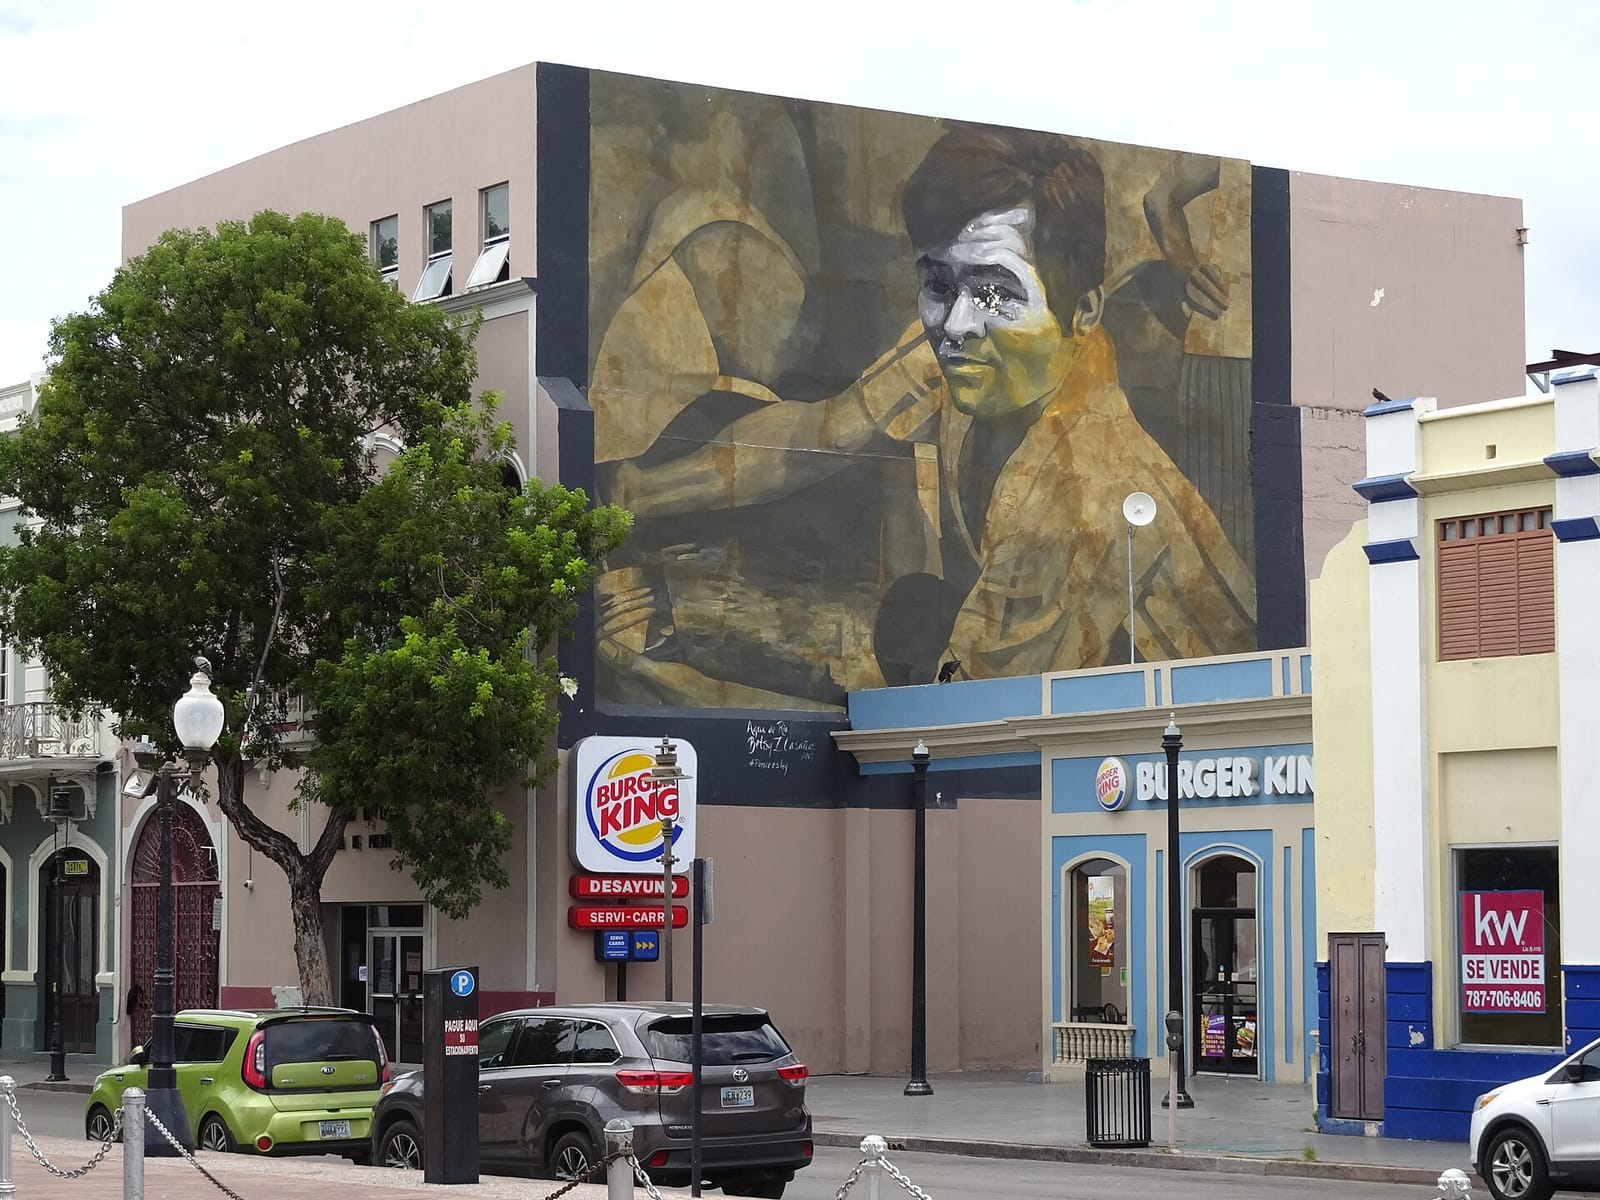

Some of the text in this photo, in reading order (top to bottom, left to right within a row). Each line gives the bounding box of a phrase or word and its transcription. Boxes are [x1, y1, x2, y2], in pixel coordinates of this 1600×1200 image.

[746, 736, 773, 758] Betsy
[1097, 767, 1119, 785] URGER
[1136, 757, 1255, 801] BURGER
[597, 772, 676, 808] BURG
[600, 788, 678, 837] KING
[590, 911, 674, 923] SERVI-CARR
[1466, 959, 1540, 979] SE VENDE
[458, 975, 469, 993] P
[1465, 990, 1541, 1007] 787-706-8406
[444, 1019, 478, 1032] PAGUE AQUI
[459, 1033, 466, 1043] SU
[445, 1045, 479, 1056] ESTACIONAMIENTO
